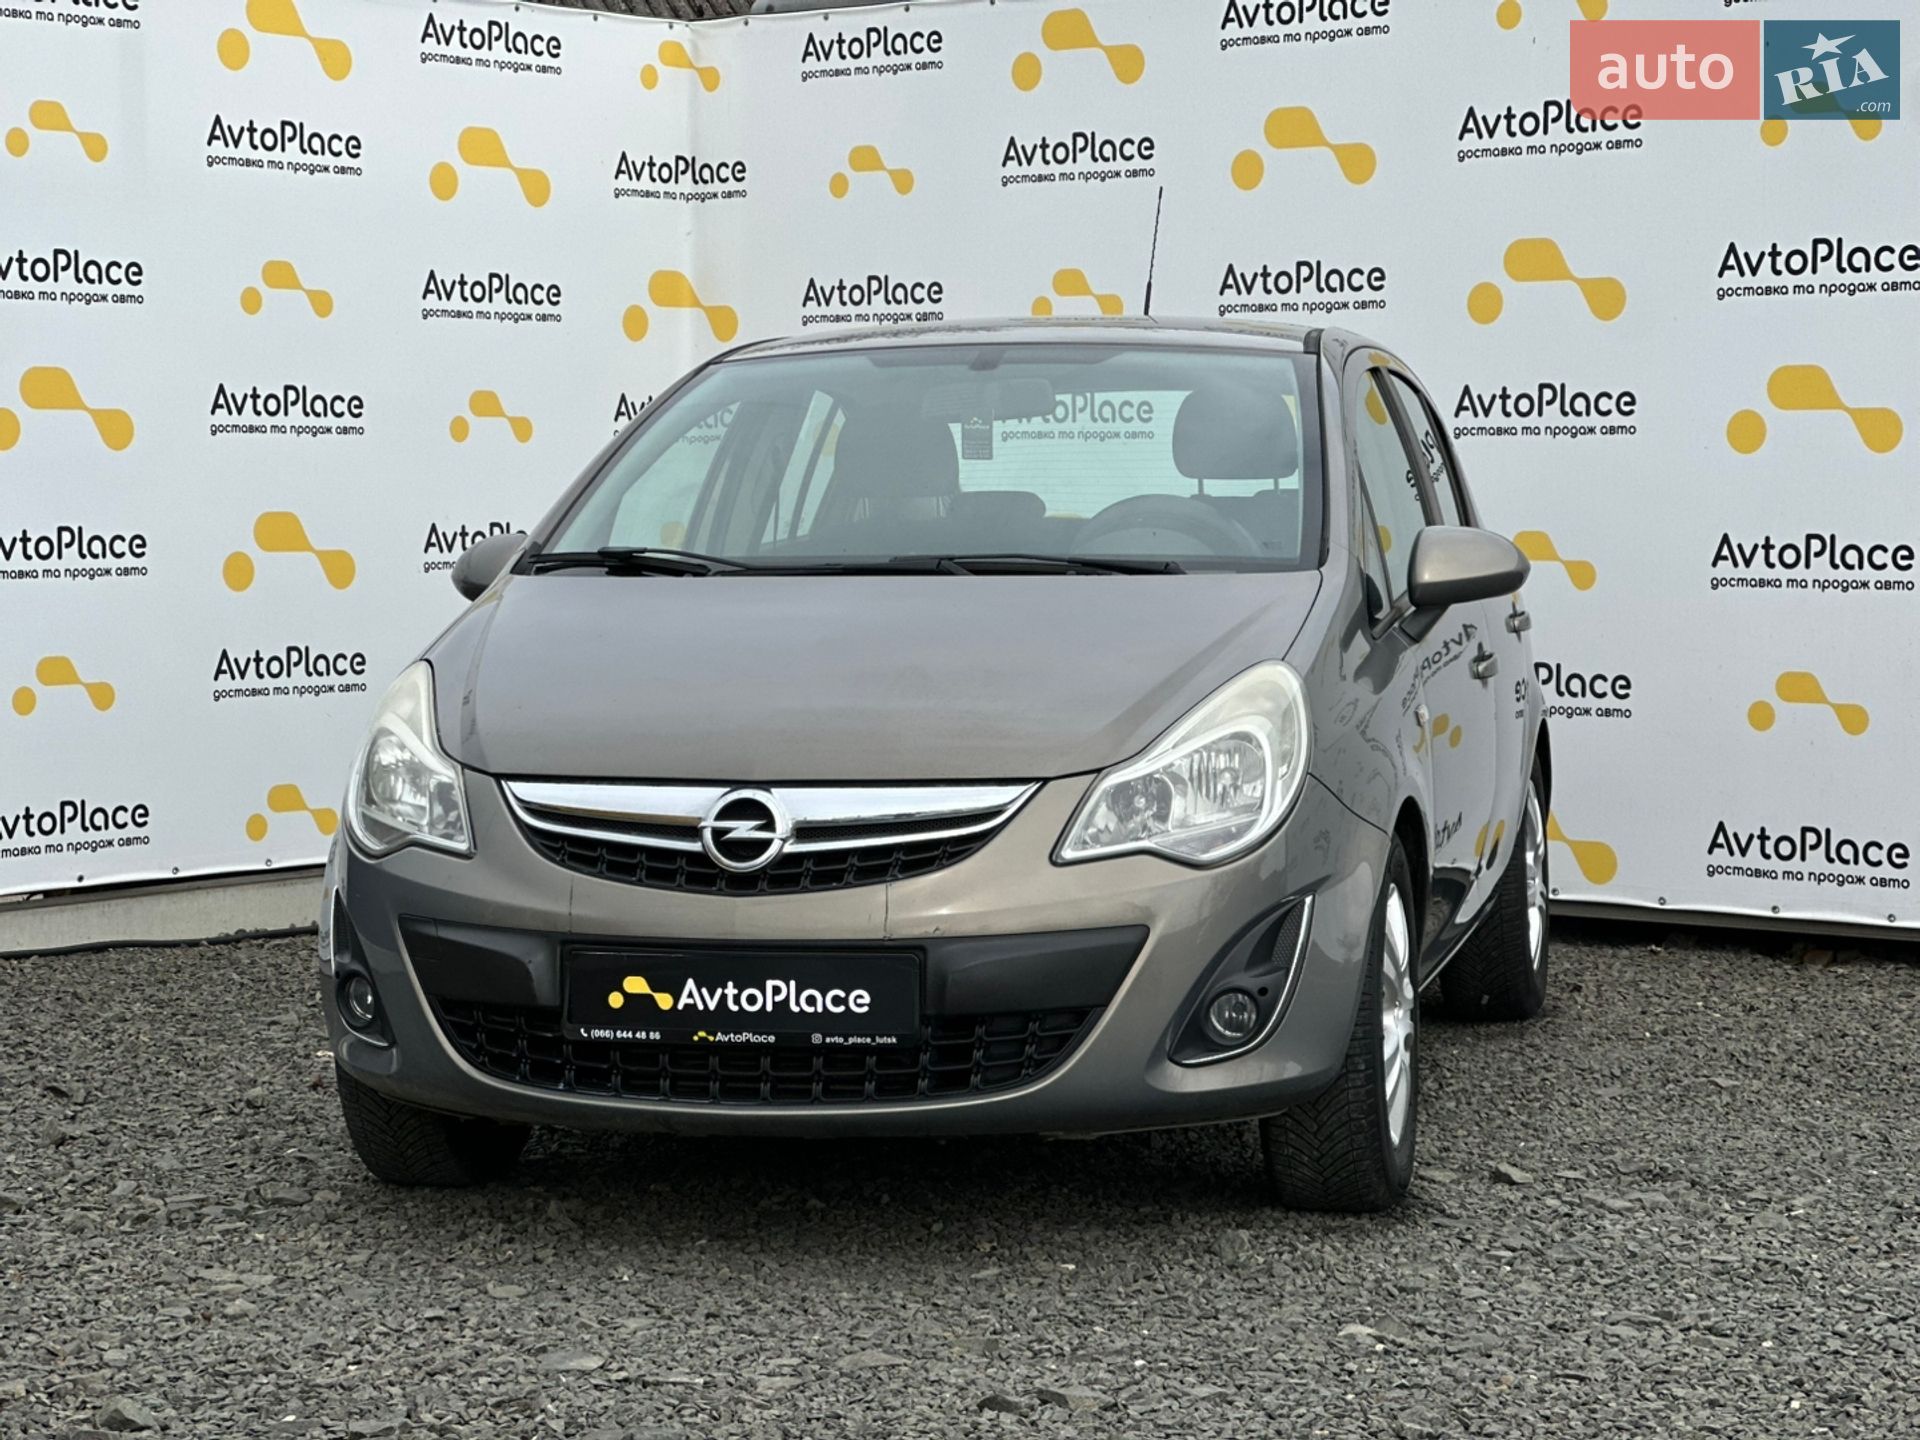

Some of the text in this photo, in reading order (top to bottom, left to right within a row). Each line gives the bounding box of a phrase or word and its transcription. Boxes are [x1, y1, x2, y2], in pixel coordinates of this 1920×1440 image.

[421, 13, 561, 58] AvtoPlace
[802, 26, 942, 63] AvtoPlace
[207, 114, 361, 159] AvtoPlace
[1458, 99, 1641, 141] AvtoPlace
[1002, 131, 1154, 168] AvtoPlace
[615, 151, 746, 185] AvtoPlace
[0, 249, 143, 286] vtoPlace
[1718, 237, 1920, 278] AvtoPlace
[422, 270, 561, 306] AvtoPlace
[802, 275, 943, 307] AvtoPlace
[1219, 260, 1386, 296] AvtoPlace
[211, 383, 363, 418] AvtoPlace
[1454, 383, 1636, 418] AvtoPlace
[0, 526, 147, 561] vtoPlace
[1711, 533, 1914, 571] AvtoPlace
[0, 569, 38, 579] тавка
[214, 646, 366, 681] AvtoPlace
[1534, 662, 1632, 700] Place
[1549, 706, 1592, 719] родаж
[0, 799, 149, 840] vtoPlace
[1, 846, 41, 858] тавка
[1707, 821, 1910, 869] AvtoPlace
[677, 977, 871, 1013] AvtoPlace
[715, 1032, 776, 1043] AvtoPlace
[825, 1034, 898, 1044] avto_place_lutsk
